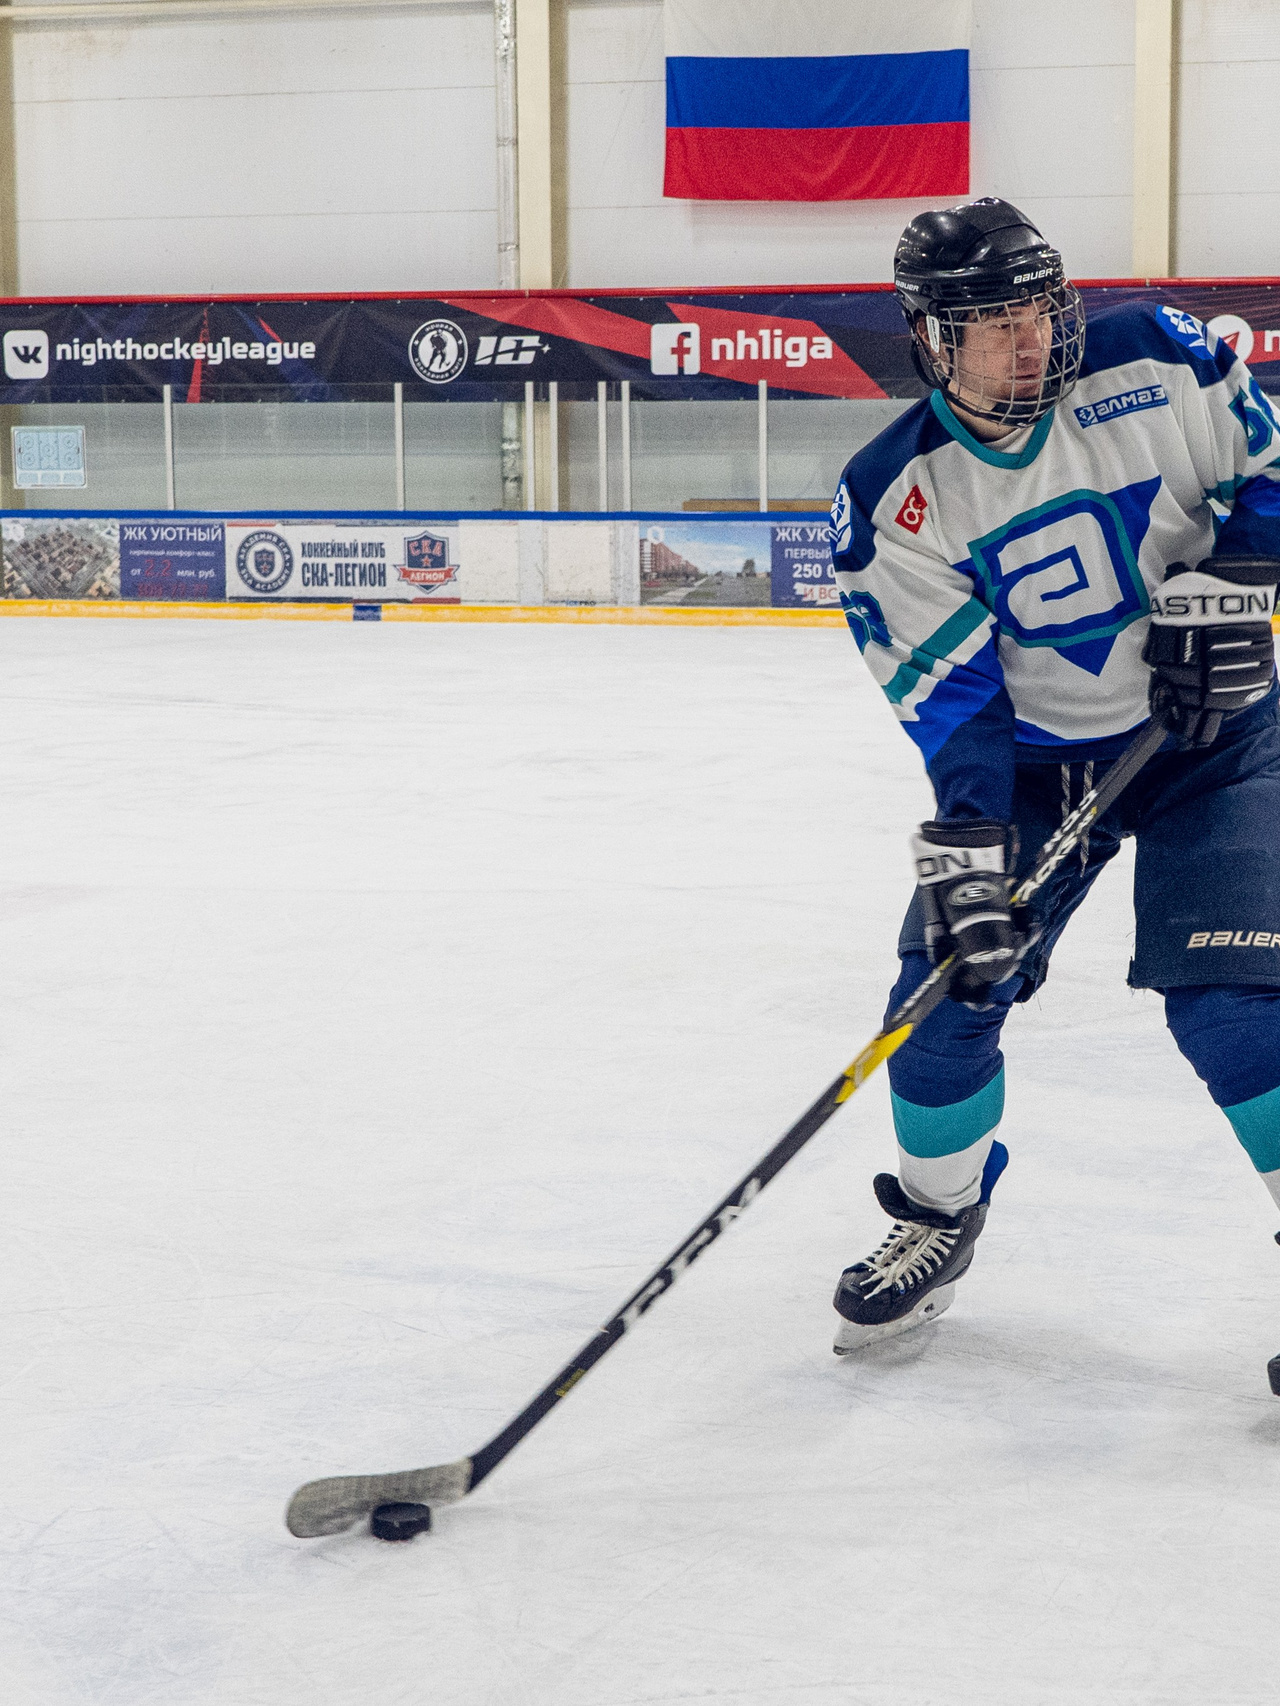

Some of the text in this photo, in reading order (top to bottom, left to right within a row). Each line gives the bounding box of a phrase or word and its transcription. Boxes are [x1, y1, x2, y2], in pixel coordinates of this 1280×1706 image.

[1013, 267, 1054, 285] BAUER
[56, 337, 316, 366] nighthockeyleague
[711, 328, 834, 368] nhliga
[123, 523, 223, 542] ЖК УЮТНЫЙ
[776, 527, 802, 542] ЖК
[301, 538, 386, 558] ХОККЕЙНЫЙ КЛУБ
[408, 538, 444, 557] СКА
[301, 562, 387, 588] СКА-ЛЕГИОН
[410, 571, 445, 581] ЛЕГИОН
[792, 563, 823, 579] 250
